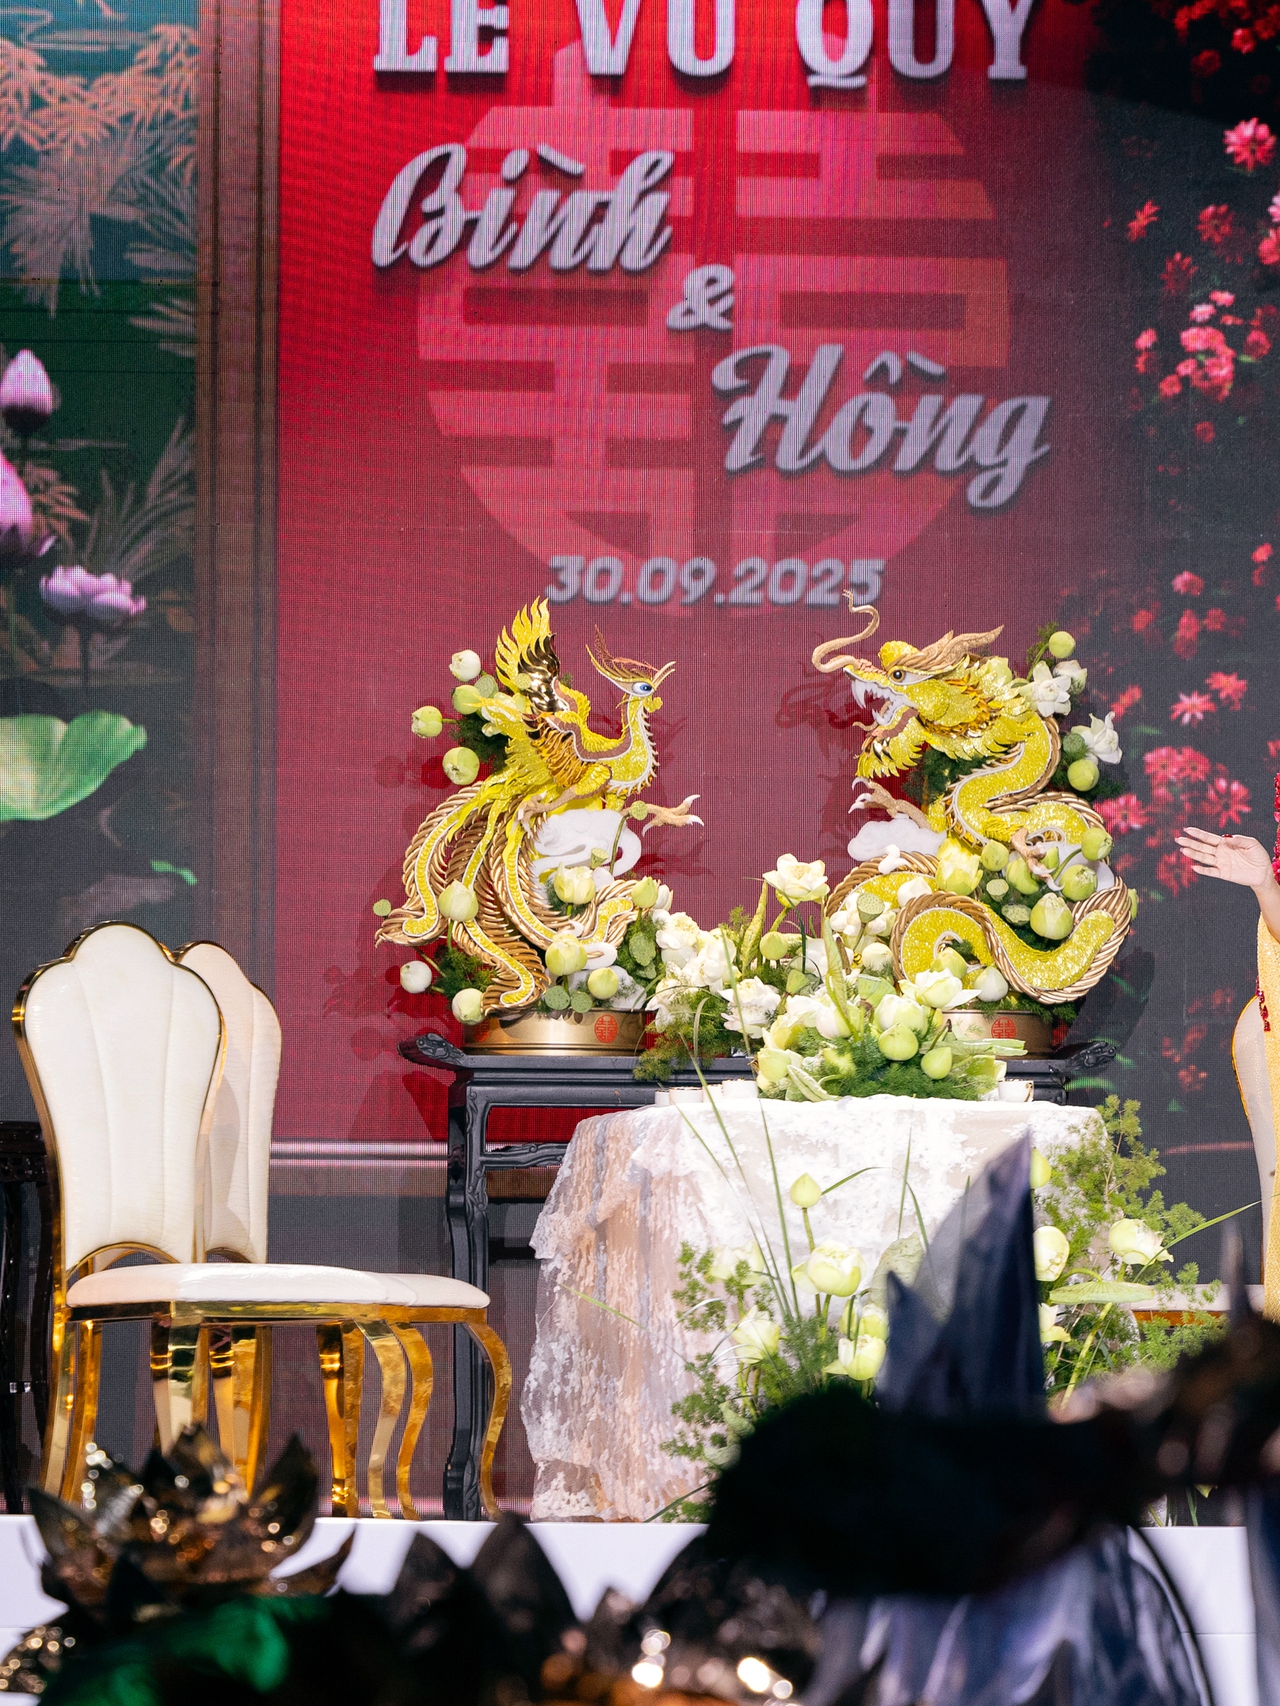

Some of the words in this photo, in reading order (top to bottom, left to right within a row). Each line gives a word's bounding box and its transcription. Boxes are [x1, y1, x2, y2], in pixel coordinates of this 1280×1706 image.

[371, 142, 676, 271] Bình
[666, 263, 736, 332] &
[711, 343, 1053, 509] Hồng
[545, 554, 887, 606] 30.09.2025
